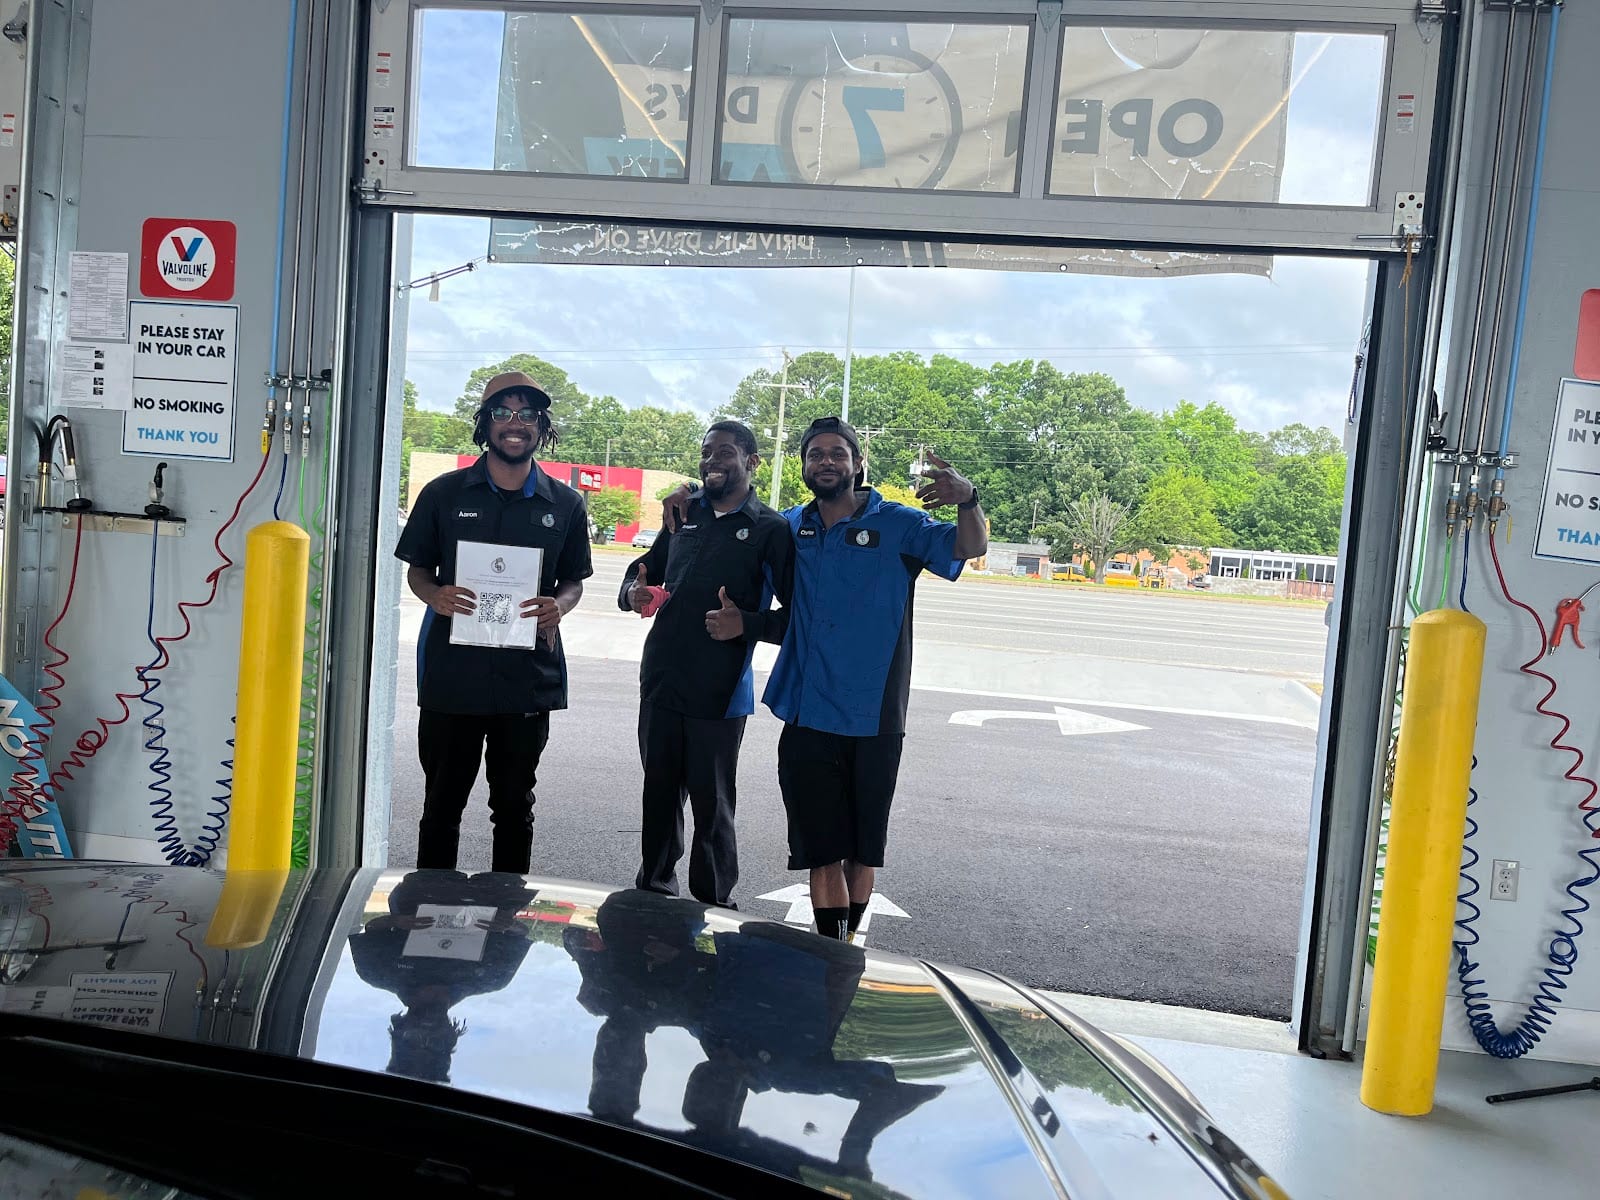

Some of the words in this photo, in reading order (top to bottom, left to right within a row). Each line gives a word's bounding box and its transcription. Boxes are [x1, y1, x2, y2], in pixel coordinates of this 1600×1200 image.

[162, 260, 208, 278] VALVOLINE
[140, 324, 190, 339] PLEASE
[193, 327, 225, 341] STAY
[137, 341, 152, 354] IN
[155, 342, 193, 357] YOUR
[196, 345, 226, 359] CAR
[133, 397, 155, 410] NO
[158, 398, 225, 415] SMOKING
[137, 427, 185, 442] THANK
[189, 431, 219, 445] YOU
[1567, 427, 1587, 444] IN
[1555, 492, 1584, 509] NO
[458, 510, 478, 519] Aaron
